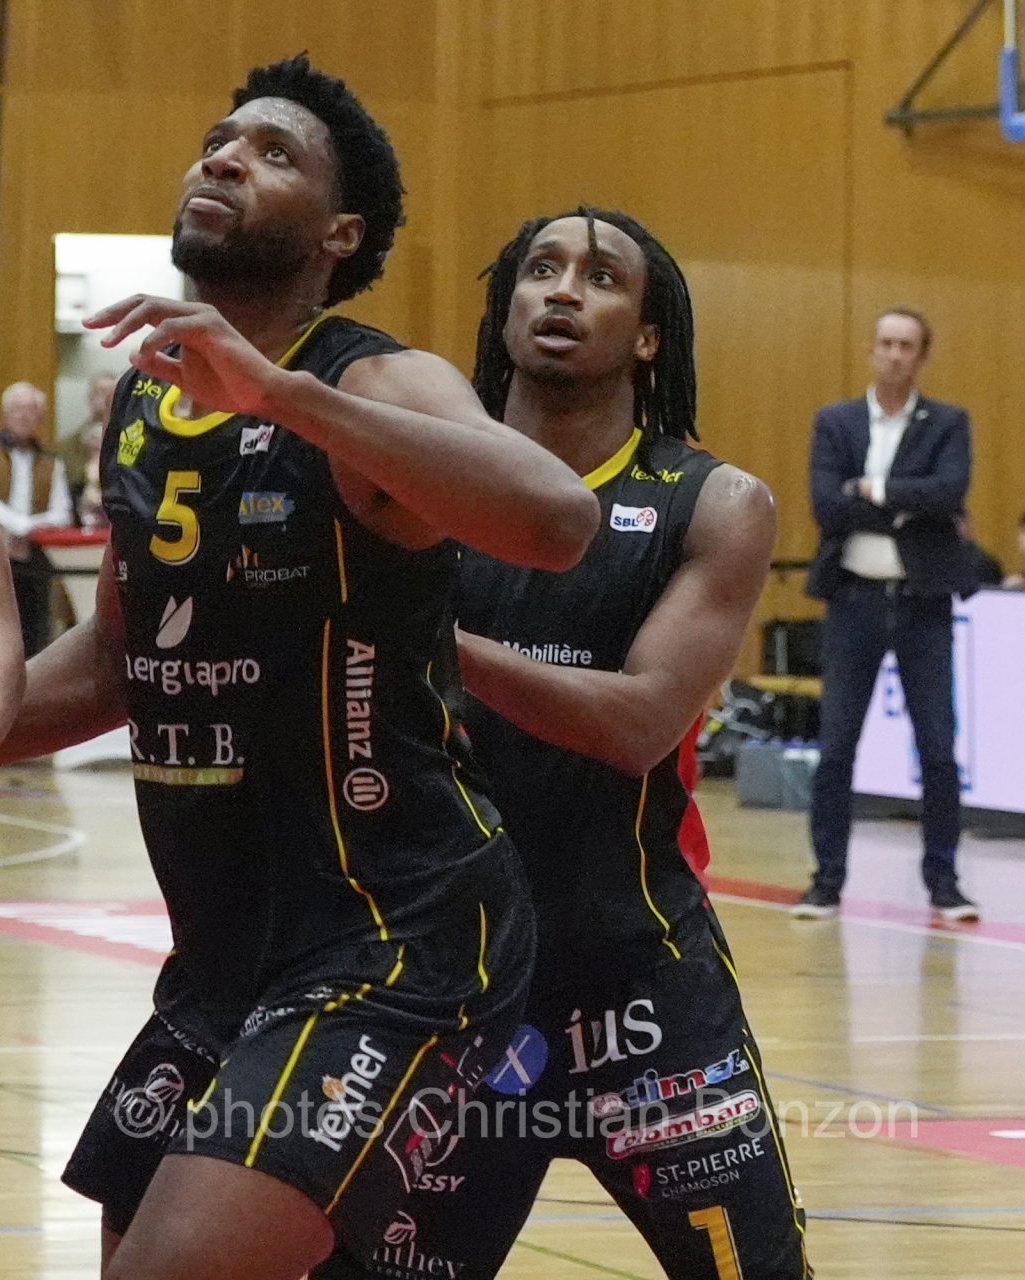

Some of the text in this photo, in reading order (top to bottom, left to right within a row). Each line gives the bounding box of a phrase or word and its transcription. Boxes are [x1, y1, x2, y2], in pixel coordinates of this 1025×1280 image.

[149, 470, 202, 565] 5
[614, 516, 639, 527] SBL
[244, 566, 311, 582] PROBAT
[345, 639, 376, 761] Allianz
[655, 1138, 766, 1185] ST-PIERRE
